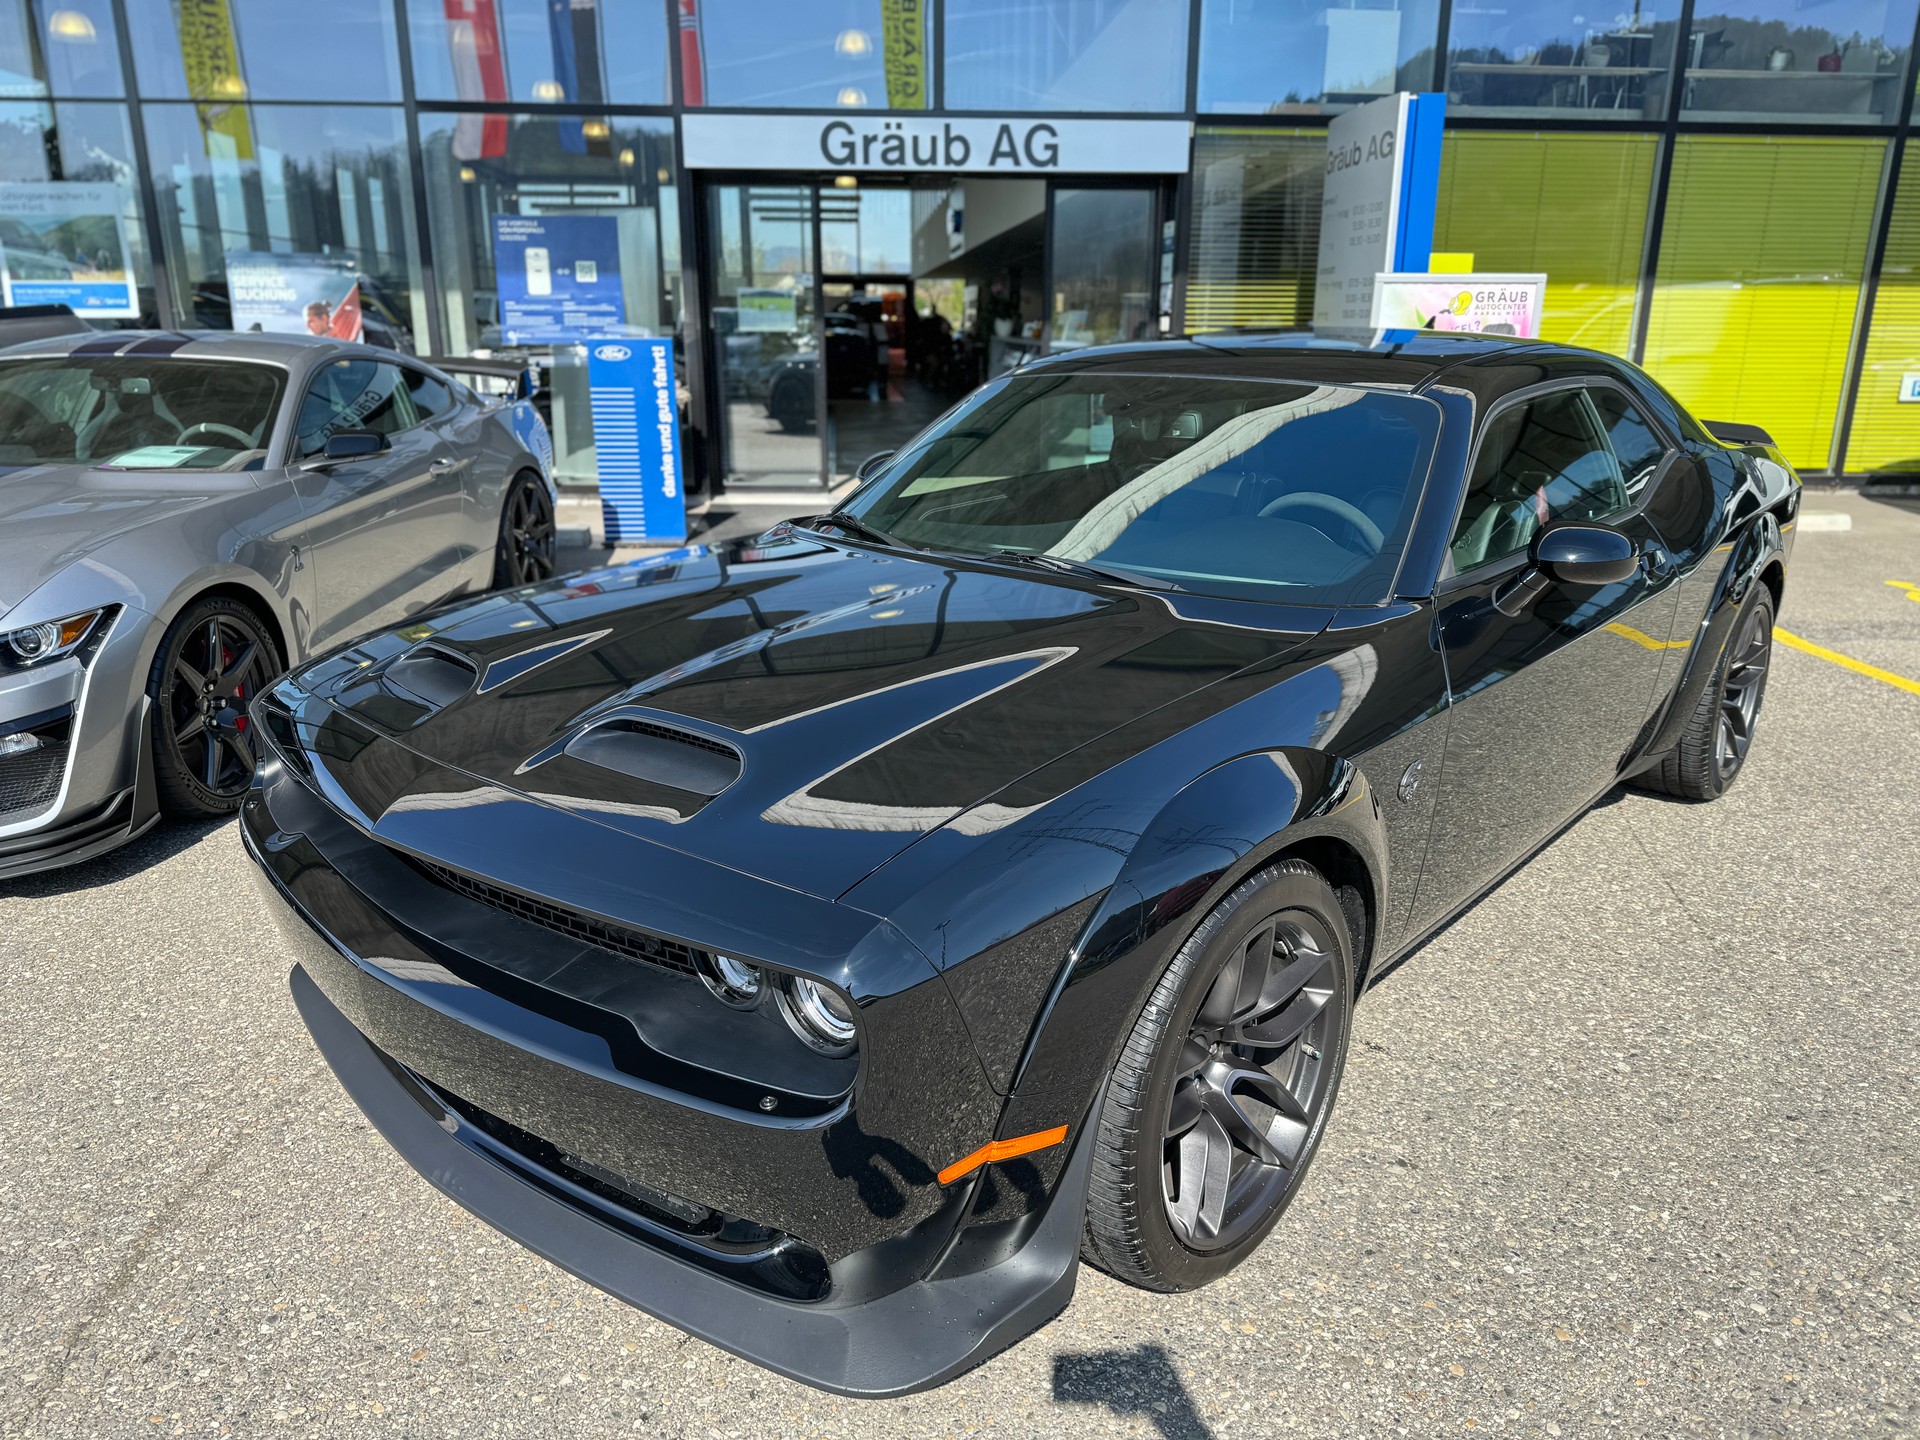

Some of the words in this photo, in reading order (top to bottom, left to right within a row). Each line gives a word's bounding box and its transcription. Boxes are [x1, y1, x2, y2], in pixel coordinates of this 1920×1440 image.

[819, 120, 972, 168] Gräub
[987, 123, 1060, 168] AG
[1326, 140, 1362, 175] Gräub
[1366, 129, 1395, 163] AG
[232, 275, 287, 288] SERVICE
[234, 287, 298, 301] BUCHUNG
[1475, 288, 1529, 303] GRÄUB
[651, 345, 668, 388] fahrt!
[656, 388, 673, 424] gute
[656, 423, 673, 453] und
[660, 453, 677, 498] danke
[231, 602, 262, 629] MICHELIN
[192, 786, 229, 809] MICHELIN
